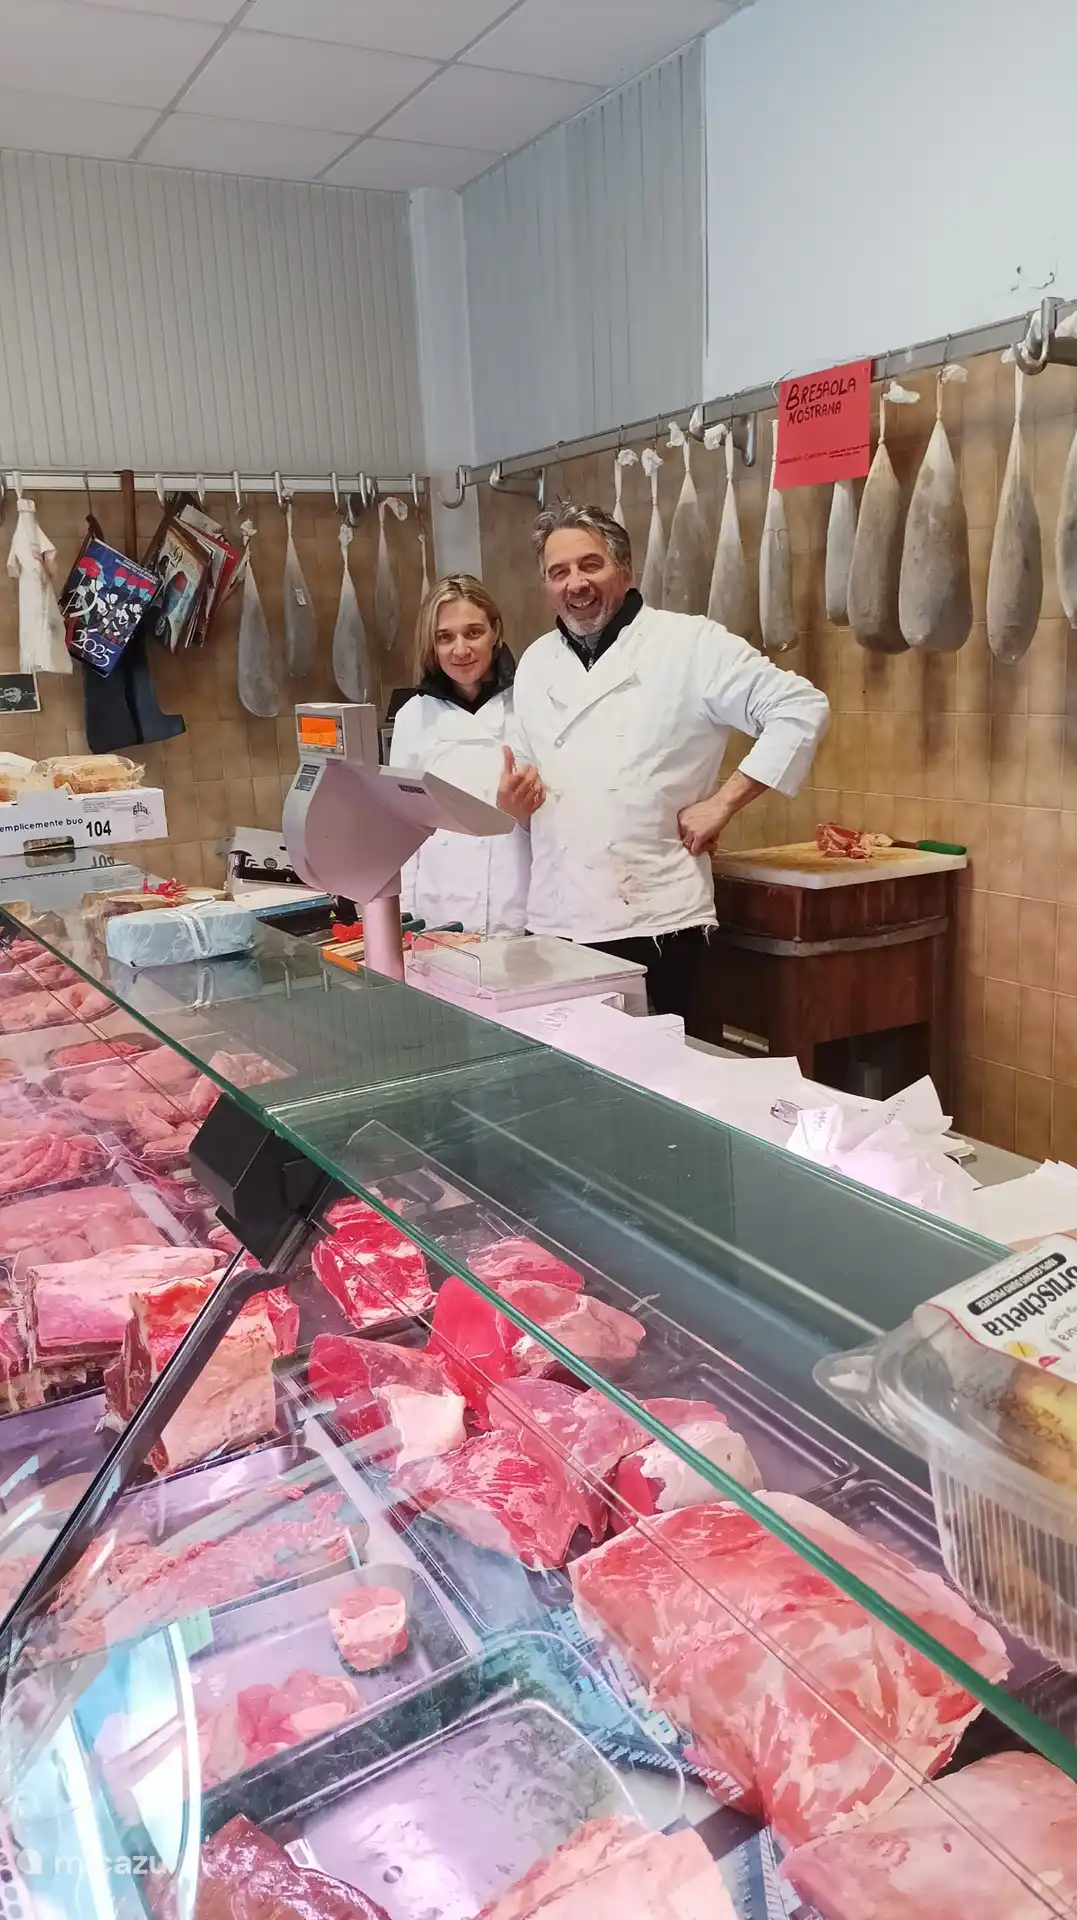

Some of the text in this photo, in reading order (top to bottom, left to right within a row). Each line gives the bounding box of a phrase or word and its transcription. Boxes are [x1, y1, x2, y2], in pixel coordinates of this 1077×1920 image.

[785, 377, 856, 410] BRESAOLA
[787, 401, 842, 427] NOSTRANA
[71, 629, 115, 667] 2025
[66, 818, 84, 826] buo
[86, 820, 112, 837] 104
